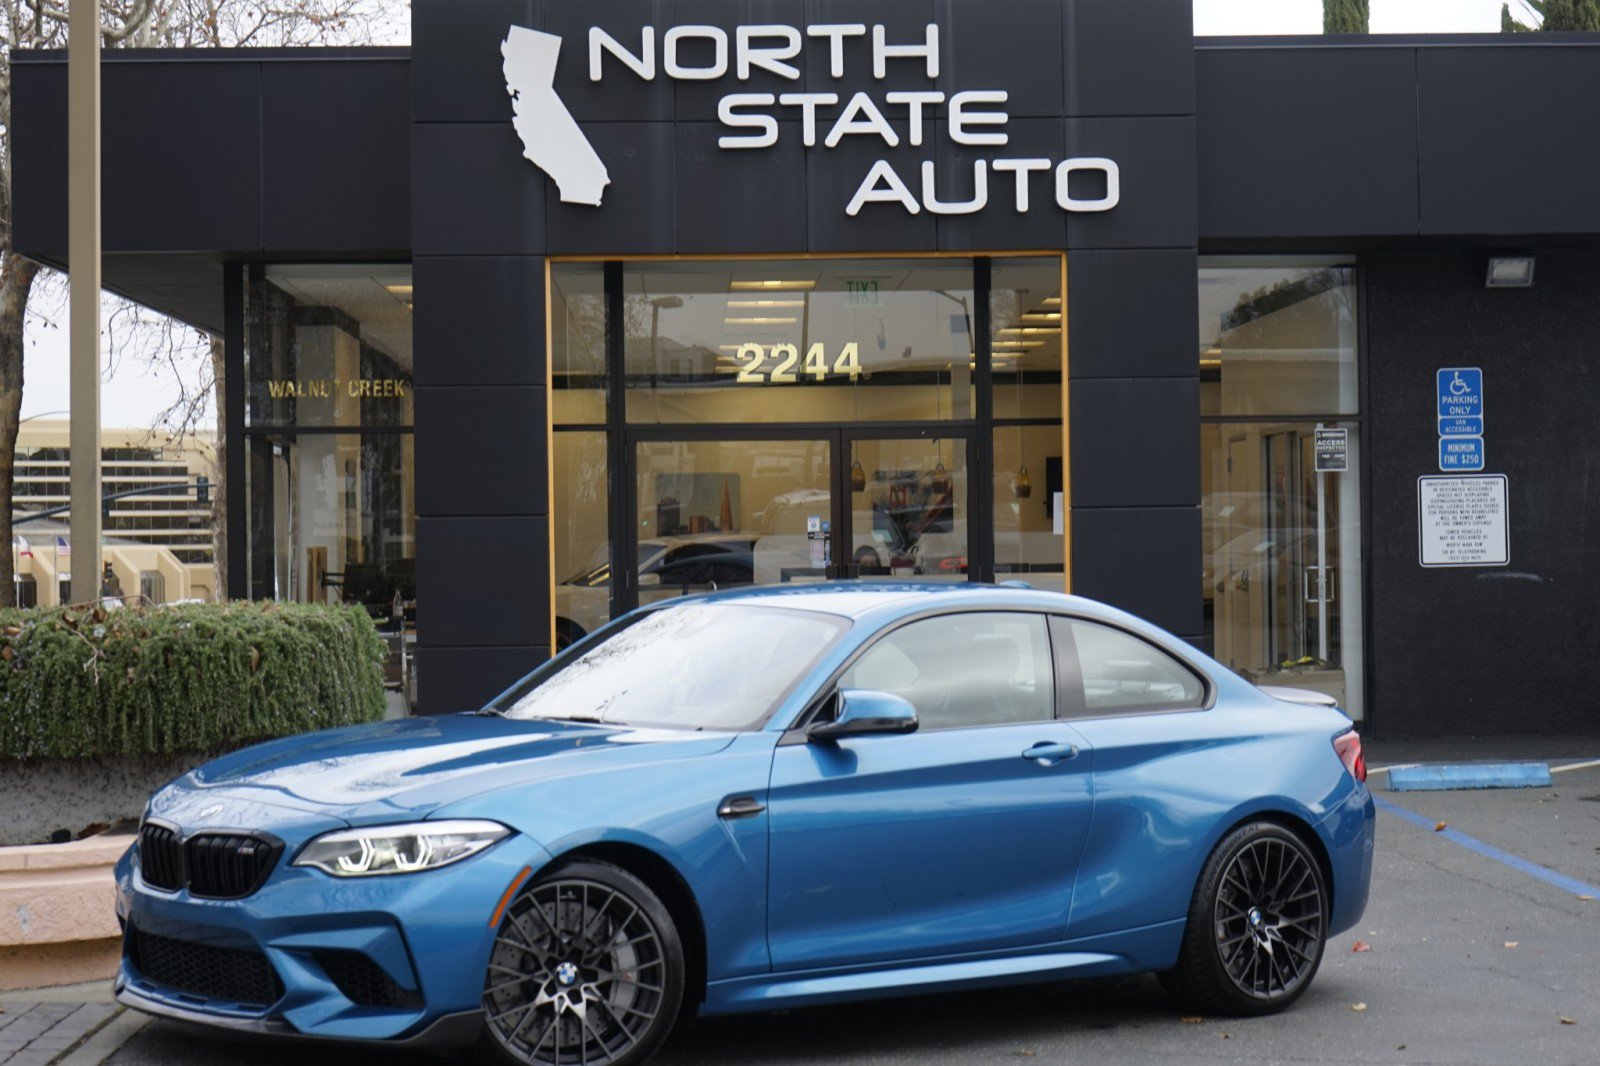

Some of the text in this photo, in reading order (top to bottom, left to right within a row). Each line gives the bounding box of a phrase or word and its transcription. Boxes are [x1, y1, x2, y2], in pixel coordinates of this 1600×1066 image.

[588, 23, 939, 82] NORTH
[717, 90, 1009, 149] STATE
[845, 157, 1121, 216] AUTO
[736, 342, 862, 382] 2244
[348, 379, 405, 398] CREEK
[1442, 395, 1478, 404] PARKING
[1449, 406, 1471, 415] ONLY
[1447, 443, 1475, 453] MINIMUM
[1444, 454, 1479, 465] FINE $250
